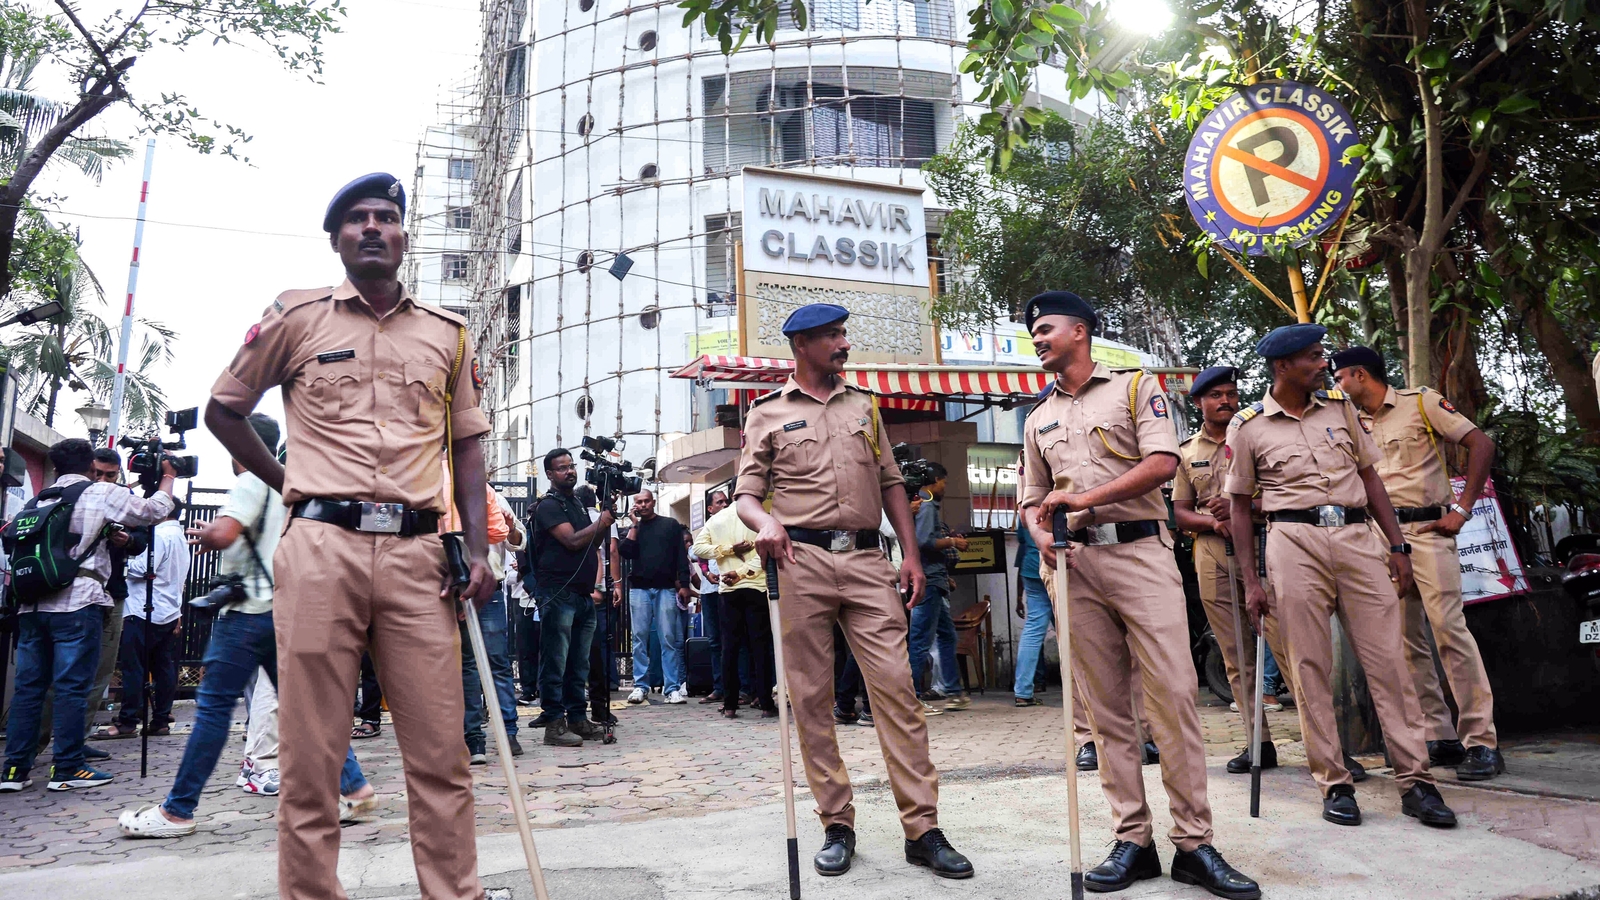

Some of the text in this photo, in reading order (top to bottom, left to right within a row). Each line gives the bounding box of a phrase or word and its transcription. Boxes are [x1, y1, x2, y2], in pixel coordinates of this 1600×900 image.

[1190, 86, 1353, 202] MAHAVIR CLASSIK
[759, 187, 912, 232] MAHAVIR
[760, 229, 915, 271] CLASSIK
[17, 516, 39, 526] TVU
